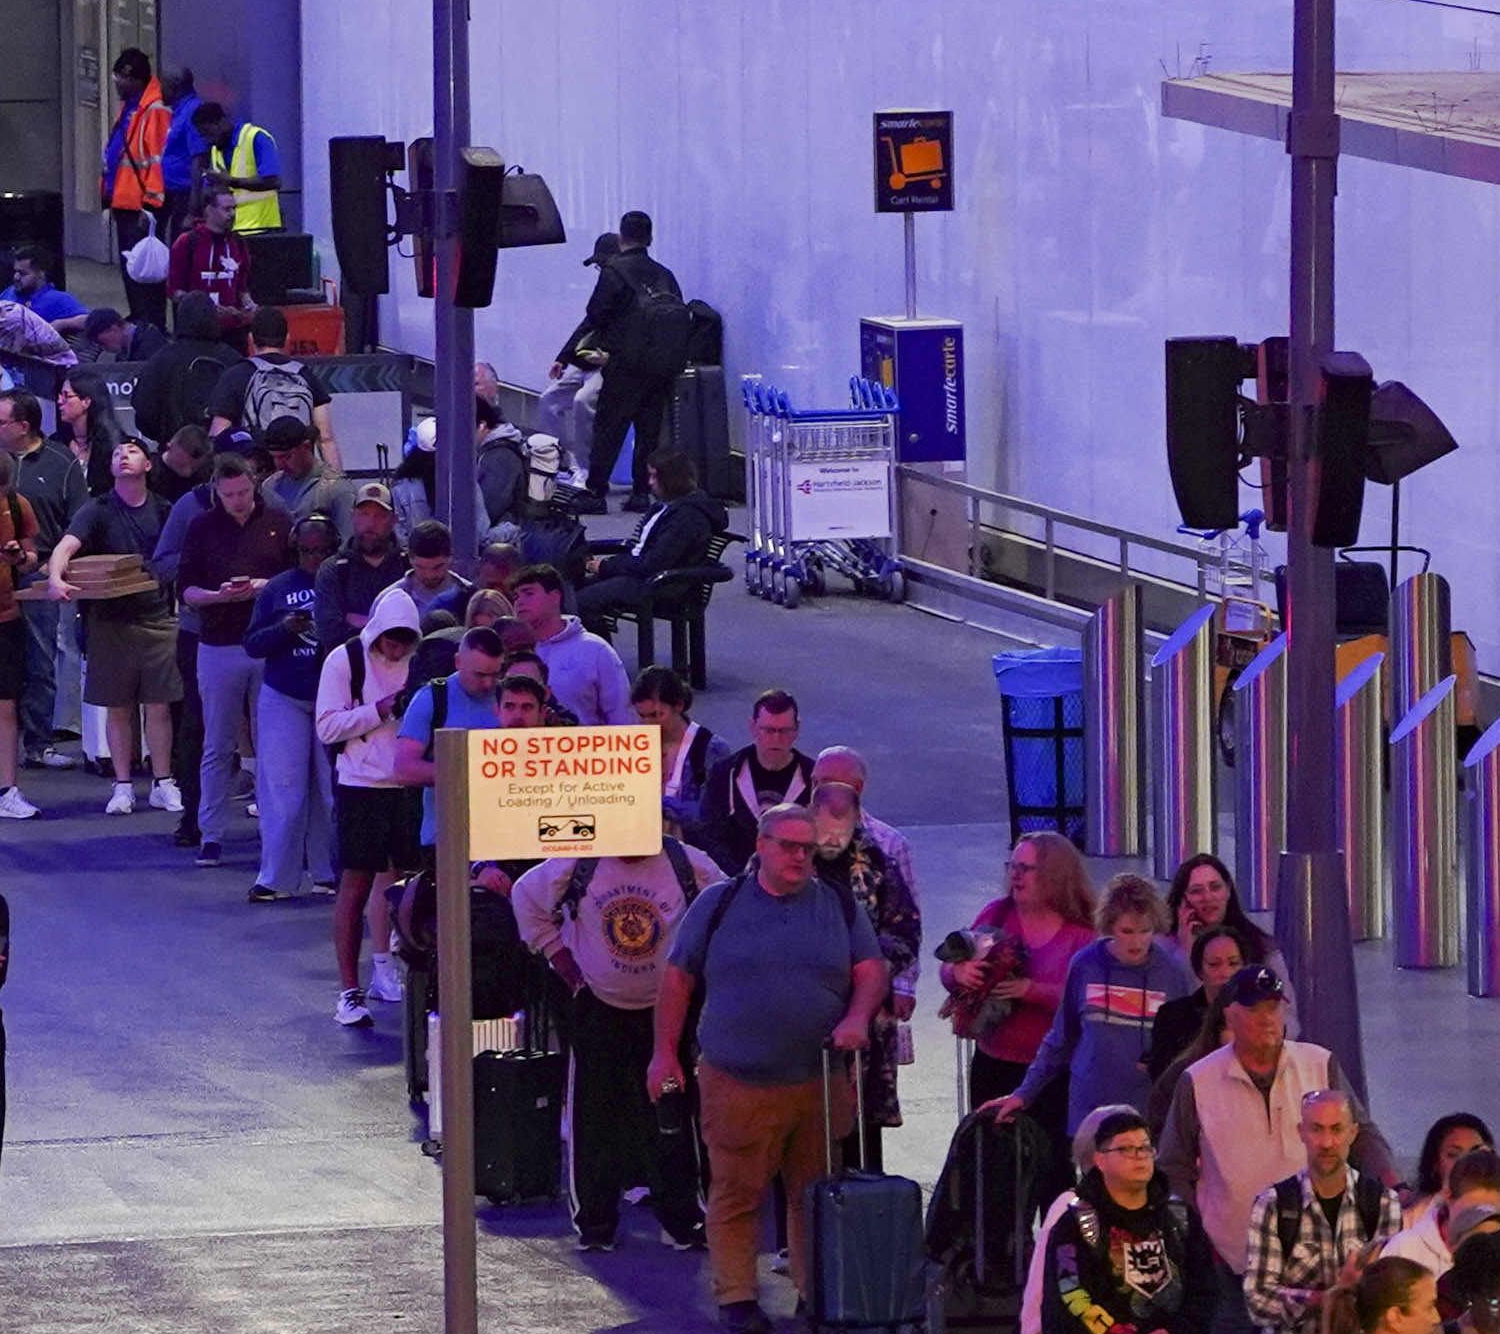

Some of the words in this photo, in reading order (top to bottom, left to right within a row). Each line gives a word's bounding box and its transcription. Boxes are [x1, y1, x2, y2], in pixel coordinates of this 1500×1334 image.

[943, 336, 958, 435] smartecarte
[482, 738, 518, 755] NO
[527, 733, 650, 754] STOPPING
[481, 761, 516, 779] OR
[524, 756, 652, 778] STANDING
[508, 783, 554, 795] Except
[559, 782, 579, 793] for
[582, 781, 625, 792] Active
[499, 796, 553, 808] Loading
[556, 795, 563, 807] /
[567, 794, 636, 808] Unloading
